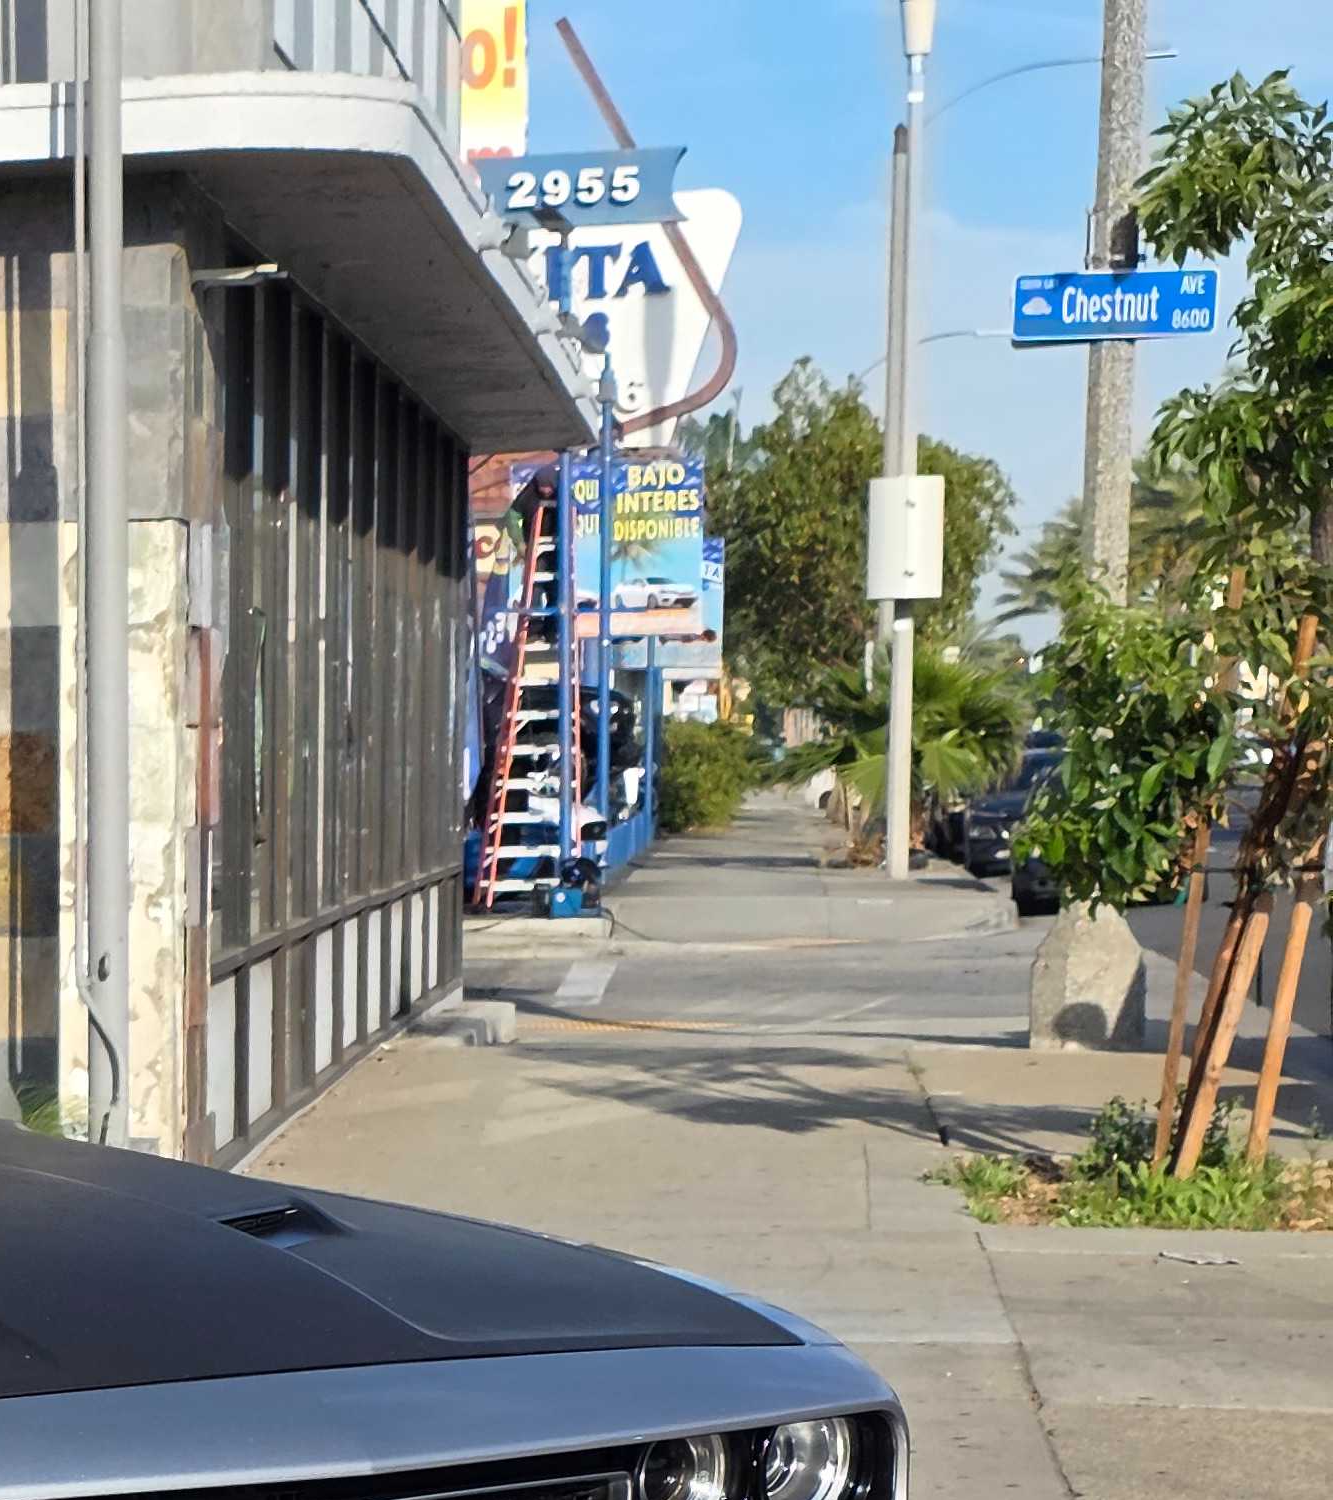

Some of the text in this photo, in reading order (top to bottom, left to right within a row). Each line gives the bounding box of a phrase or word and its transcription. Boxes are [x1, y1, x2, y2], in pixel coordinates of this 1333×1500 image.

[506, 165, 641, 211] 2955
[1180, 274, 1207, 295] AVE
[1061, 285, 1161, 324] Chestnut
[1171, 307, 1210, 330] 8600
[627, 462, 686, 489] BAJO
[616, 489, 700, 514] INTERES
[613, 516, 700, 542] DISPONIBLE
